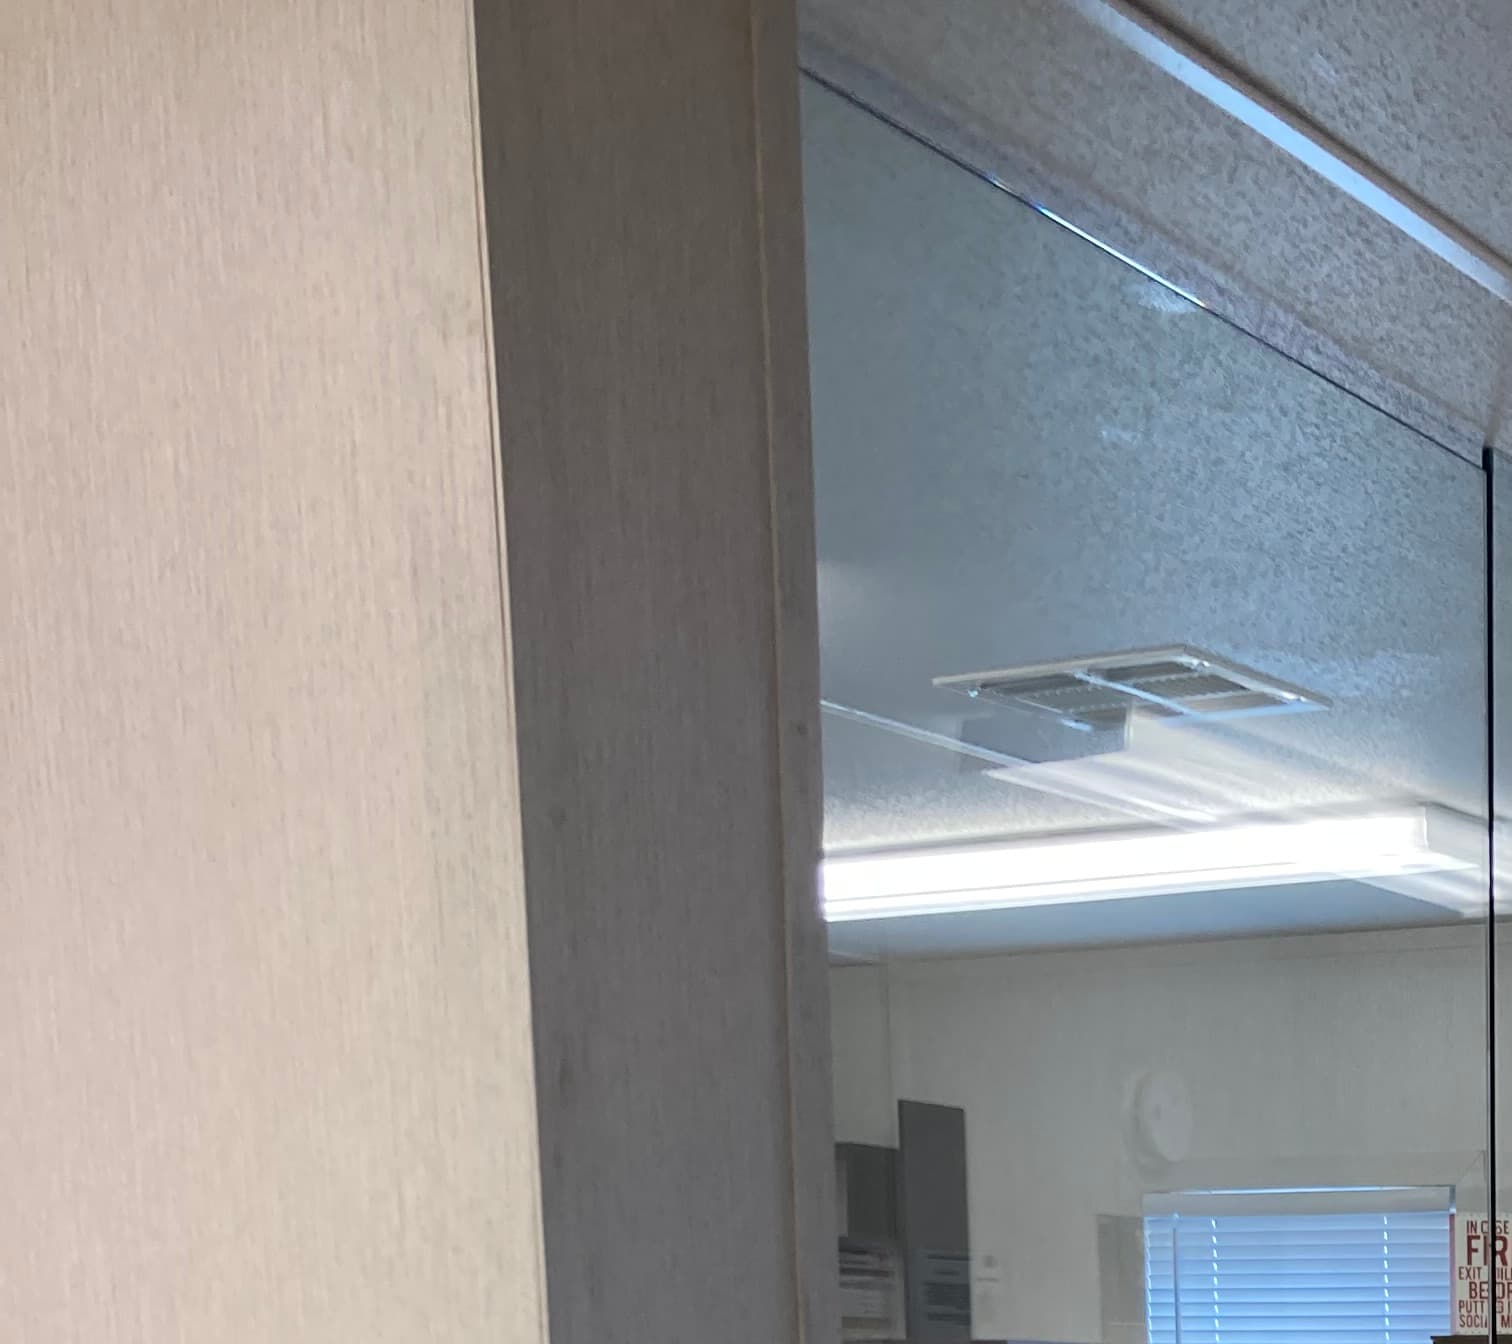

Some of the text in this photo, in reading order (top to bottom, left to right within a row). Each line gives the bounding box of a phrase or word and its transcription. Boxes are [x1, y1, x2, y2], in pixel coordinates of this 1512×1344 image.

[1466, 1220, 1478, 1234] IN
[1481, 1220, 1509, 1234] CSE
[1458, 1266, 1482, 1281] EXIT
